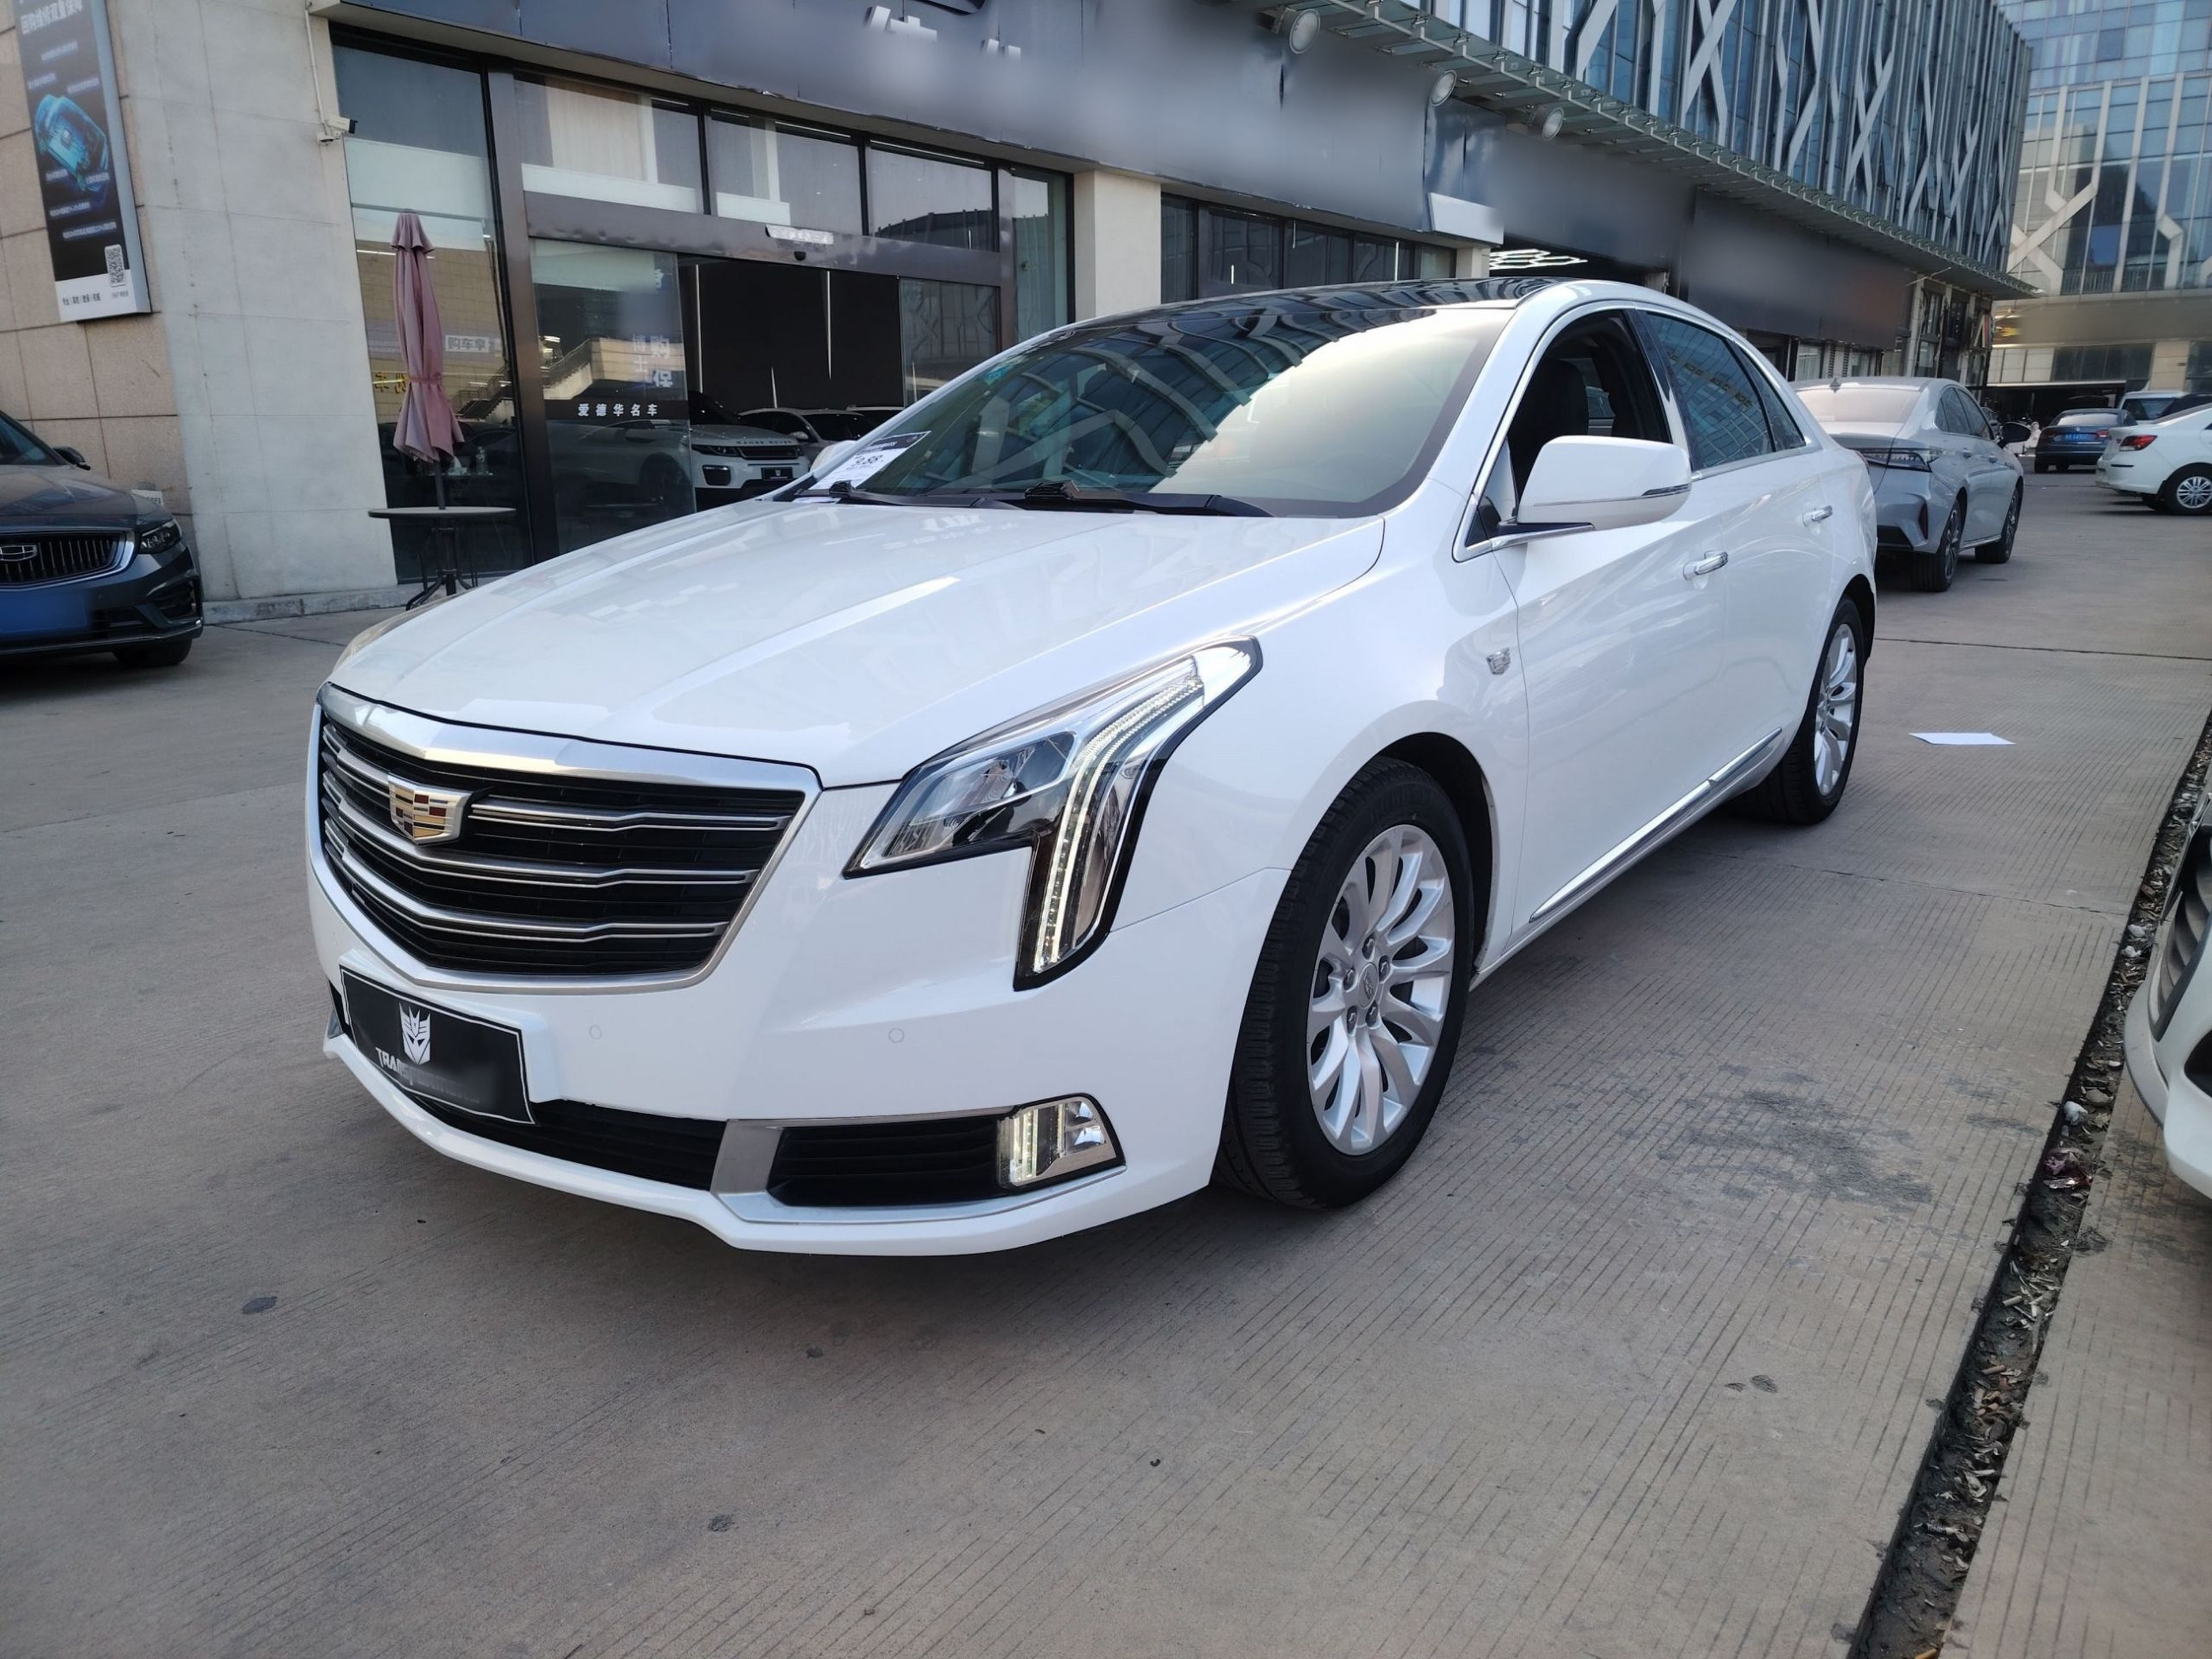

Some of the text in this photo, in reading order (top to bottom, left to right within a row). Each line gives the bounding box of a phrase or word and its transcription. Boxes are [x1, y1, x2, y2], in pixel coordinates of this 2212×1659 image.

[578, 403, 658, 417] 爱德华名车
